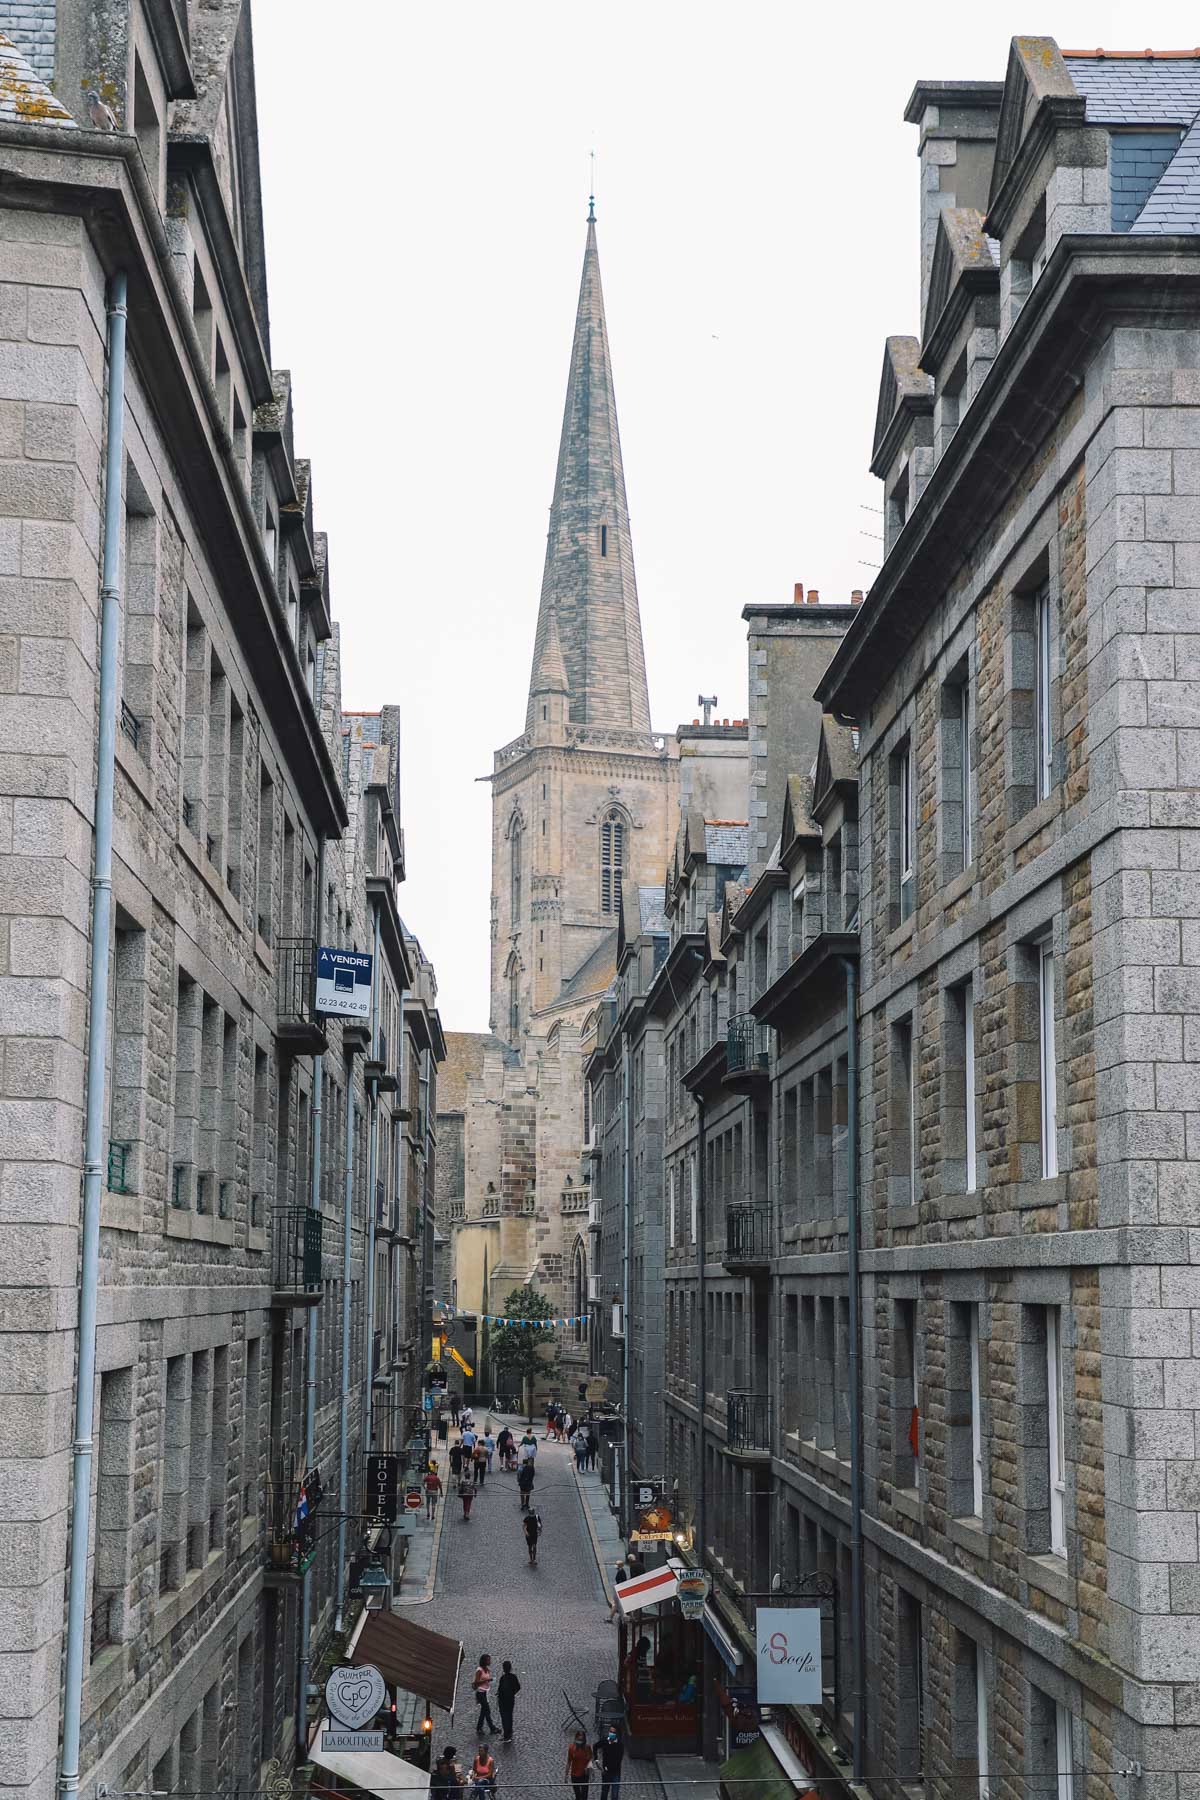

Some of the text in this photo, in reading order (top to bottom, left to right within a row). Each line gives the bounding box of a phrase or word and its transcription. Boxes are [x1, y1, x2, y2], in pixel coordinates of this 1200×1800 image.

[321, 952, 369, 967] À VENDRE
[329, 999, 337, 1007] 23
[339, 1001, 347, 1009] 42
[349, 1002, 357, 1010] 42
[377, 1459, 387, 1516] HOTEL
[770, 1632, 812, 1673] Scoop
[325, 1735, 380, 1748] LA BOUTIQUE
